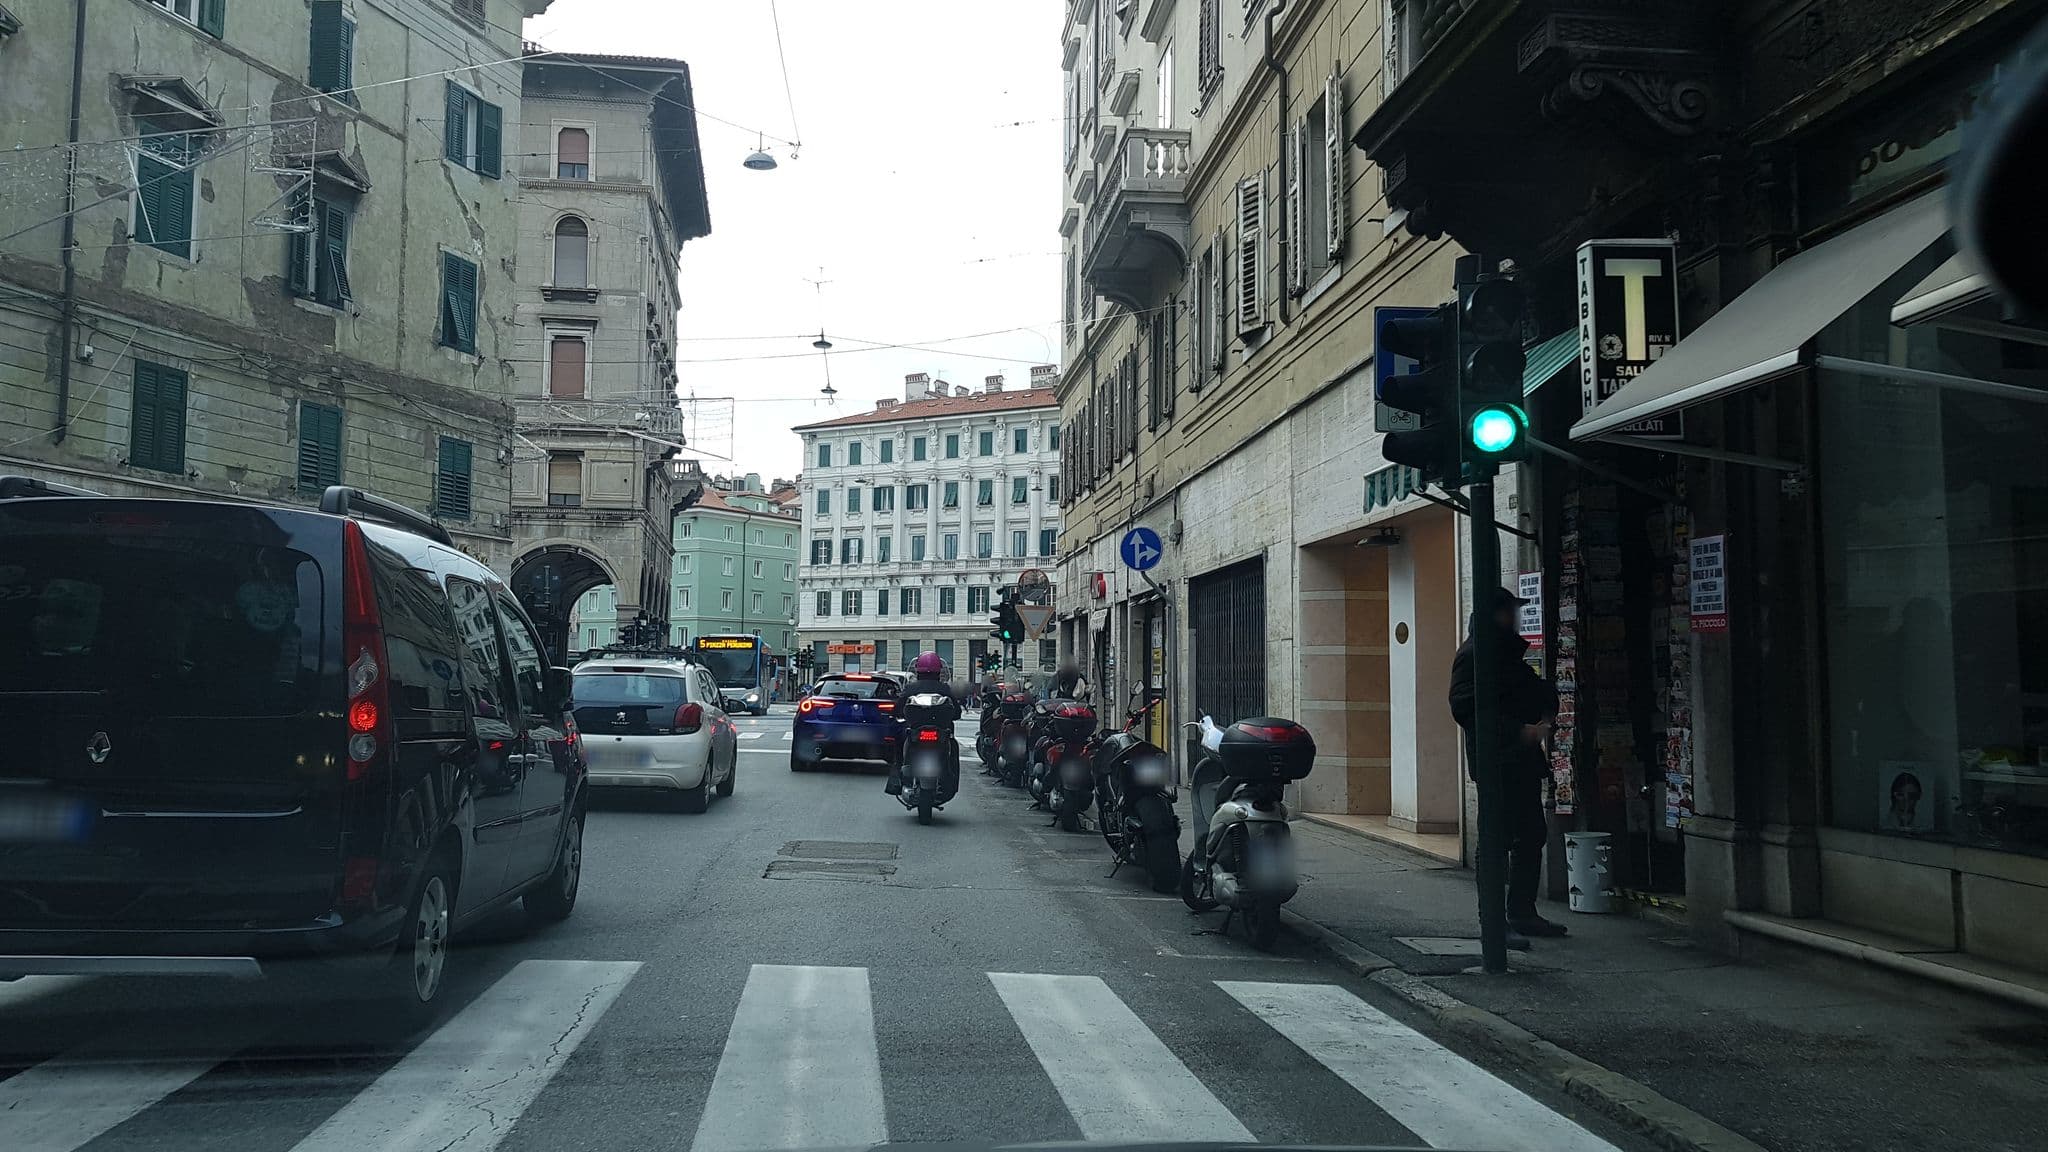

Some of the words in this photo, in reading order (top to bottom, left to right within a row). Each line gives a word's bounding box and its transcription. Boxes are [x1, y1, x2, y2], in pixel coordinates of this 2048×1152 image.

[1604, 258, 1662, 361] T
[1699, 618, 1726, 629] PICCOLO
[826, 644, 876, 654] BOSCO
